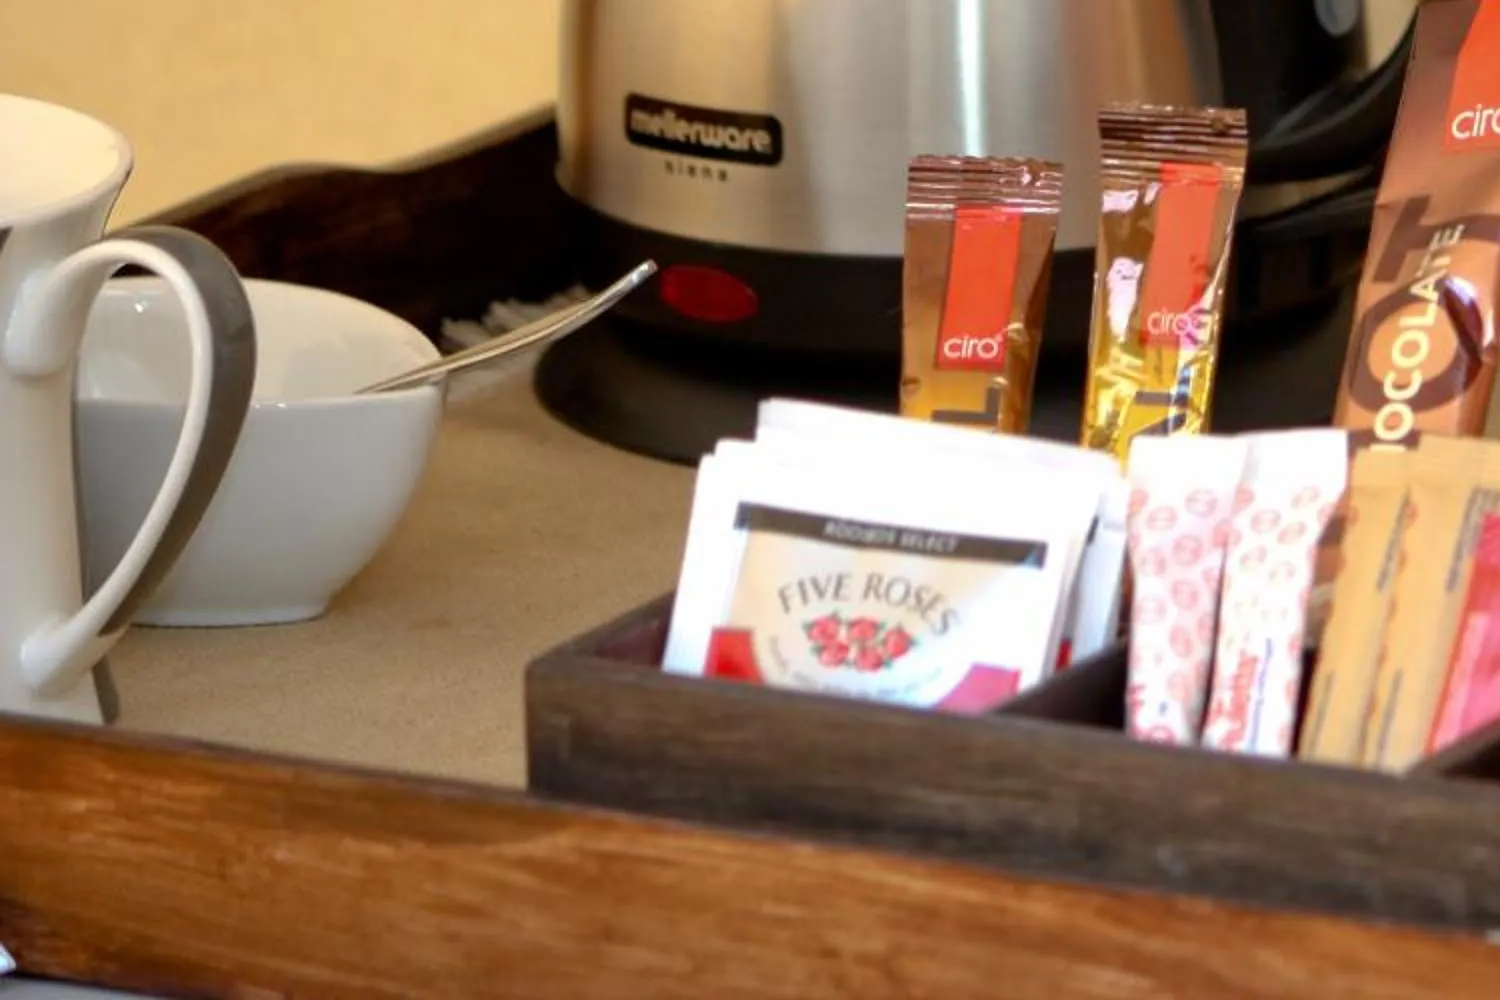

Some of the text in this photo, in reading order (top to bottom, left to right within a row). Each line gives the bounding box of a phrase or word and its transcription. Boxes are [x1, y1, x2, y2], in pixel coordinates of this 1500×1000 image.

[943, 333, 999, 360] ciro
[776, 571, 963, 637] FIVE ROSES
